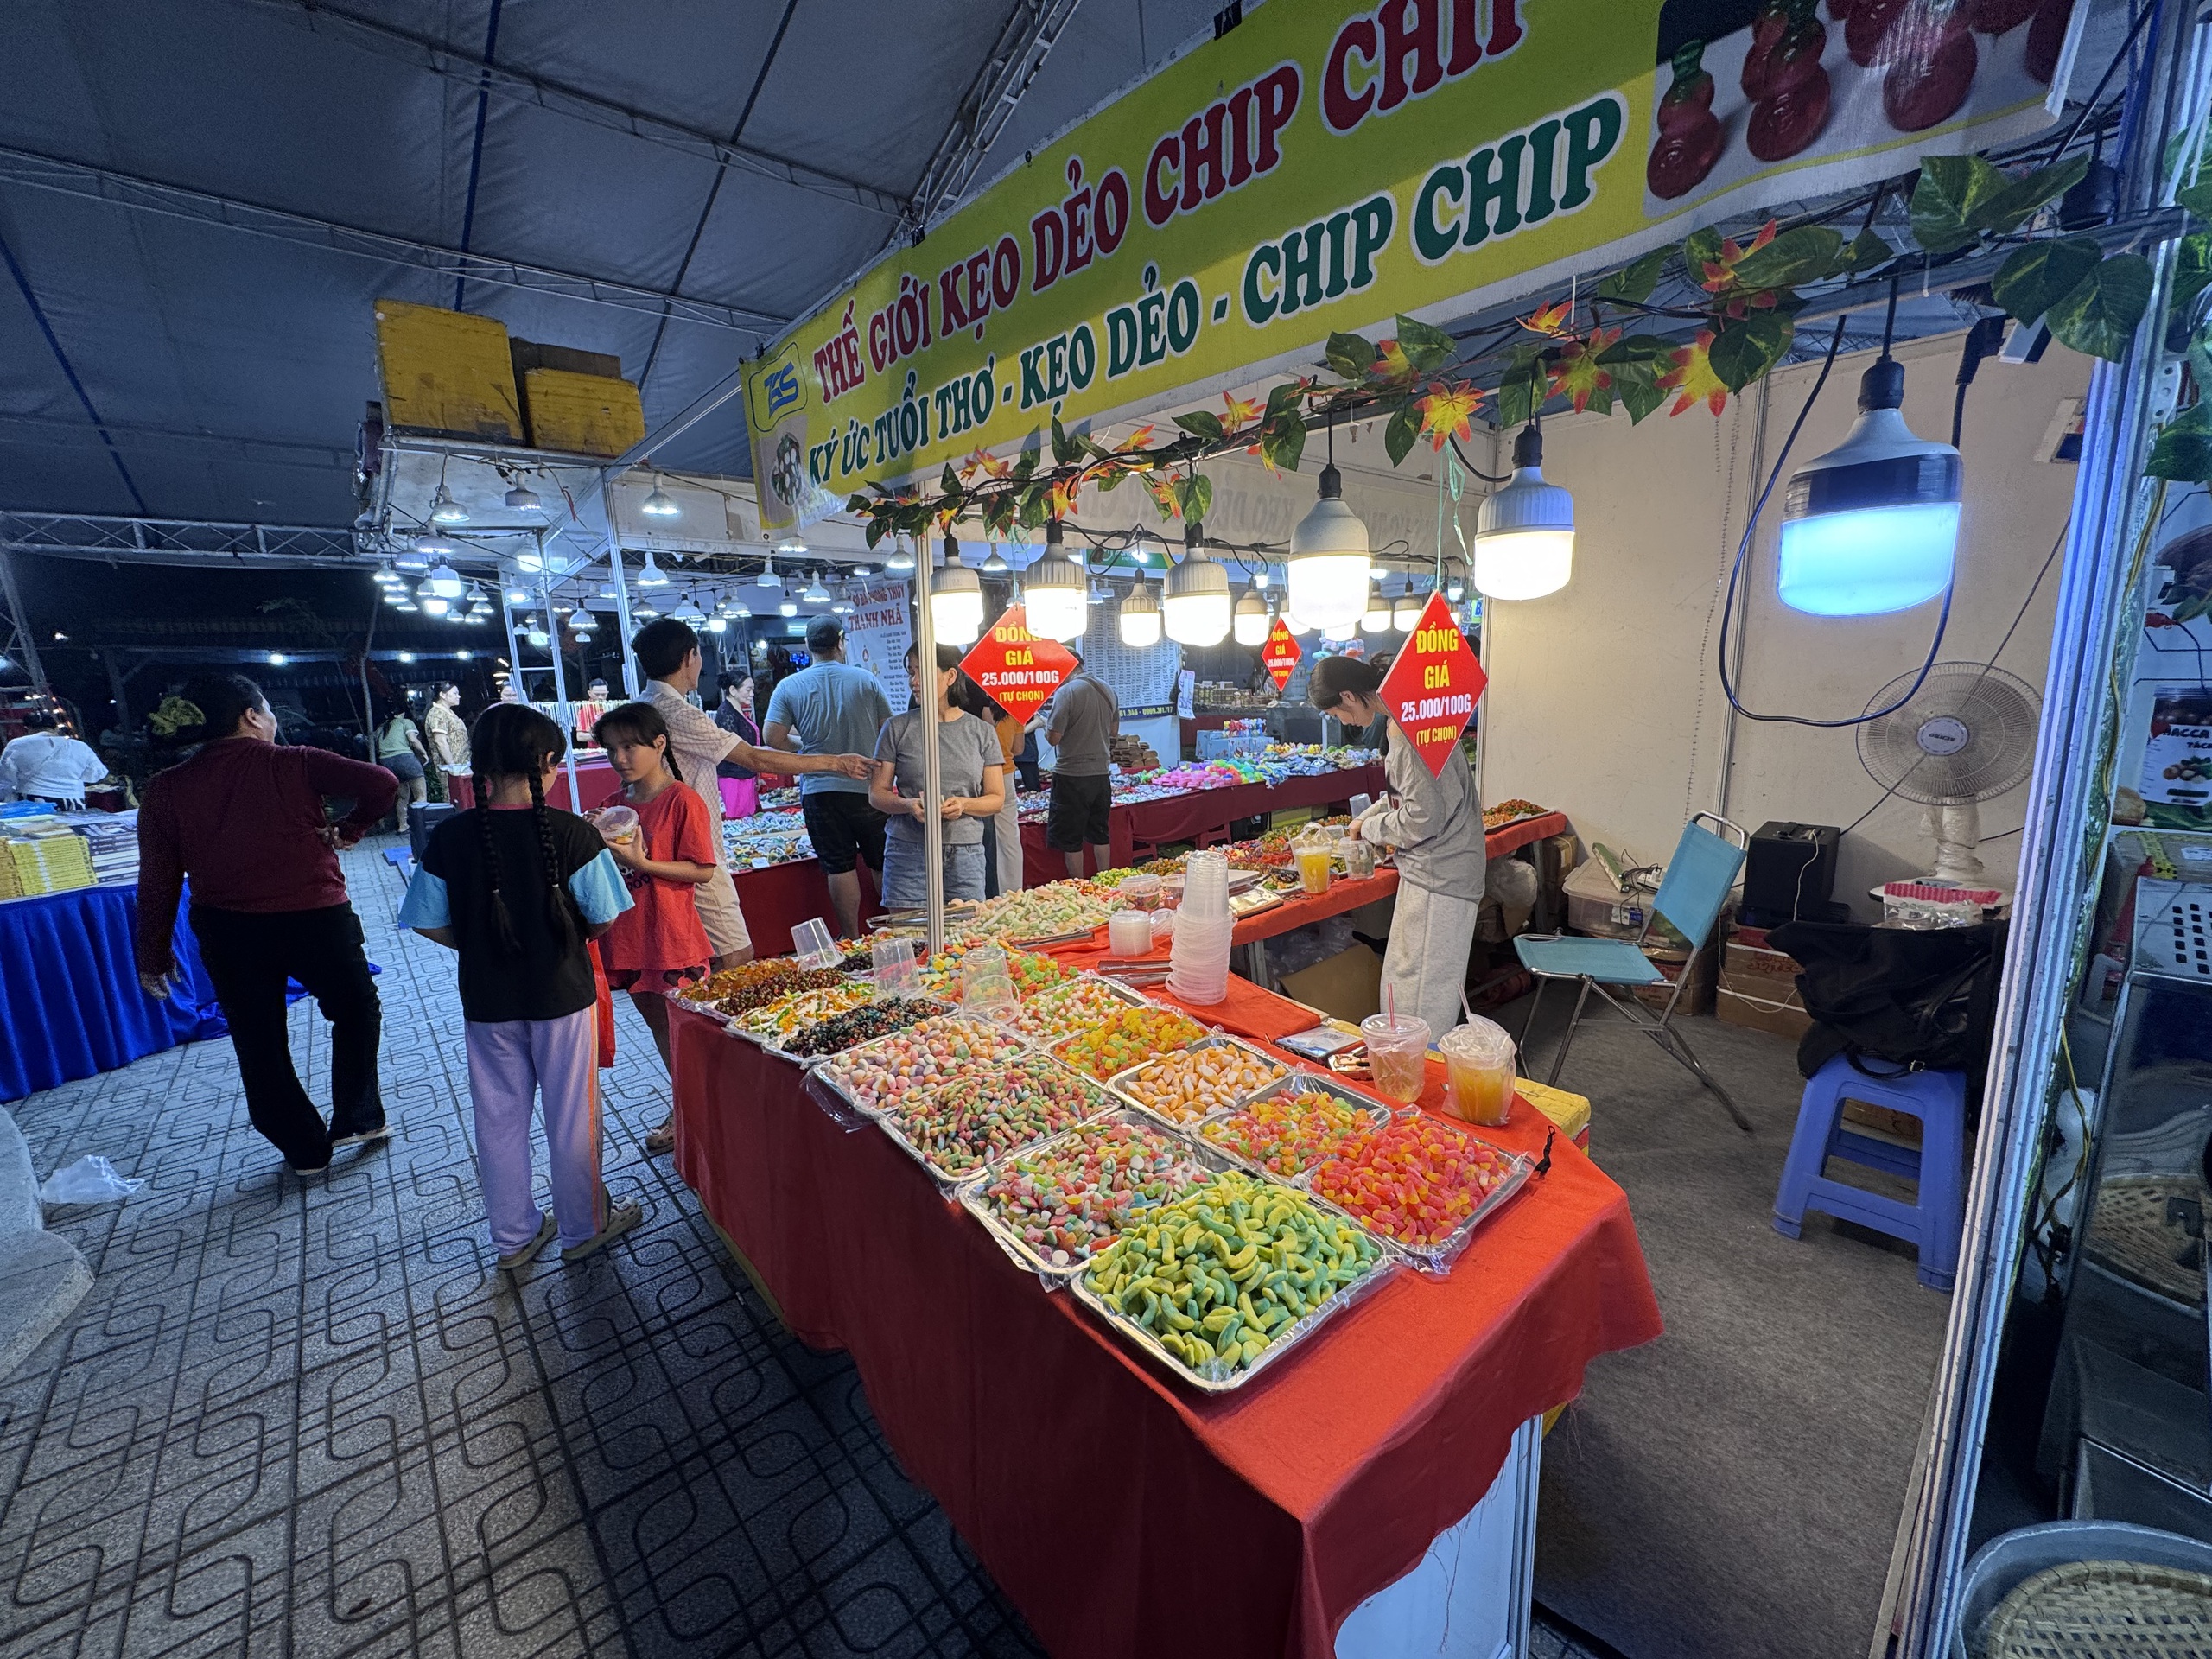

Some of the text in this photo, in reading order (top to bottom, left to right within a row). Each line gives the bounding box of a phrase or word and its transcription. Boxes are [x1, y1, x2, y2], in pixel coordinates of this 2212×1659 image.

[813, 299, 865, 404] THẾ
[869, 275, 931, 372] GIỚI
[939, 236, 1020, 340] KẸO
[1031, 158, 1129, 292] DẺO
[1145, 65, 1300, 226] CHIP
[842, 419, 870, 475] ỨC
[874, 371, 929, 463] TUỔI
[935, 354, 995, 438] THƠ
[1020, 325, 1096, 416] KẸO
[1107, 265, 1199, 378] DẺO
[1243, 196, 1393, 325] CHIP
[1414, 98, 1622, 260] CHIP
[1275, 644, 1286, 655] GIÁ
[1416, 621, 1459, 654] ĐỒNG
[1005, 645, 1034, 666] GIÁ
[981, 670, 1060, 687] 25.000/100G
[1424, 659, 1450, 690] GIÁ
[999, 690, 1044, 704] (TỰ CHỌN)
[1400, 693, 1471, 722] 25.000/100G
[1416, 725, 1458, 747] (TỰ CHỌN)
